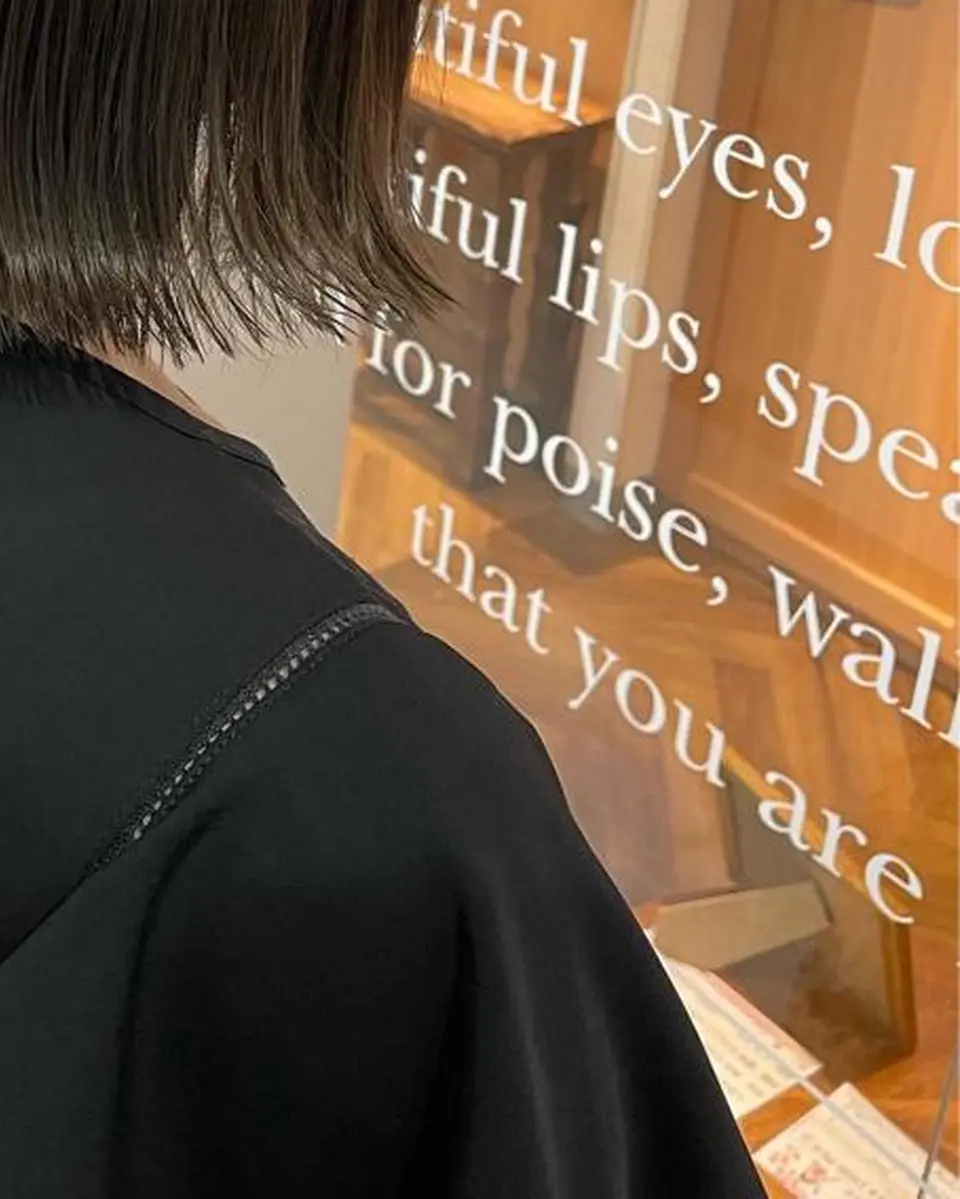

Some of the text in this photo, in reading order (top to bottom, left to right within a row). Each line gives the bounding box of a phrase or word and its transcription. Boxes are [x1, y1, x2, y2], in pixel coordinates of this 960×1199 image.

[615, 92, 832, 250] eyes,
[548, 222, 721, 404] lips,
[485, 394, 728, 606] poise,
[412, 503, 924, 925] that you are
